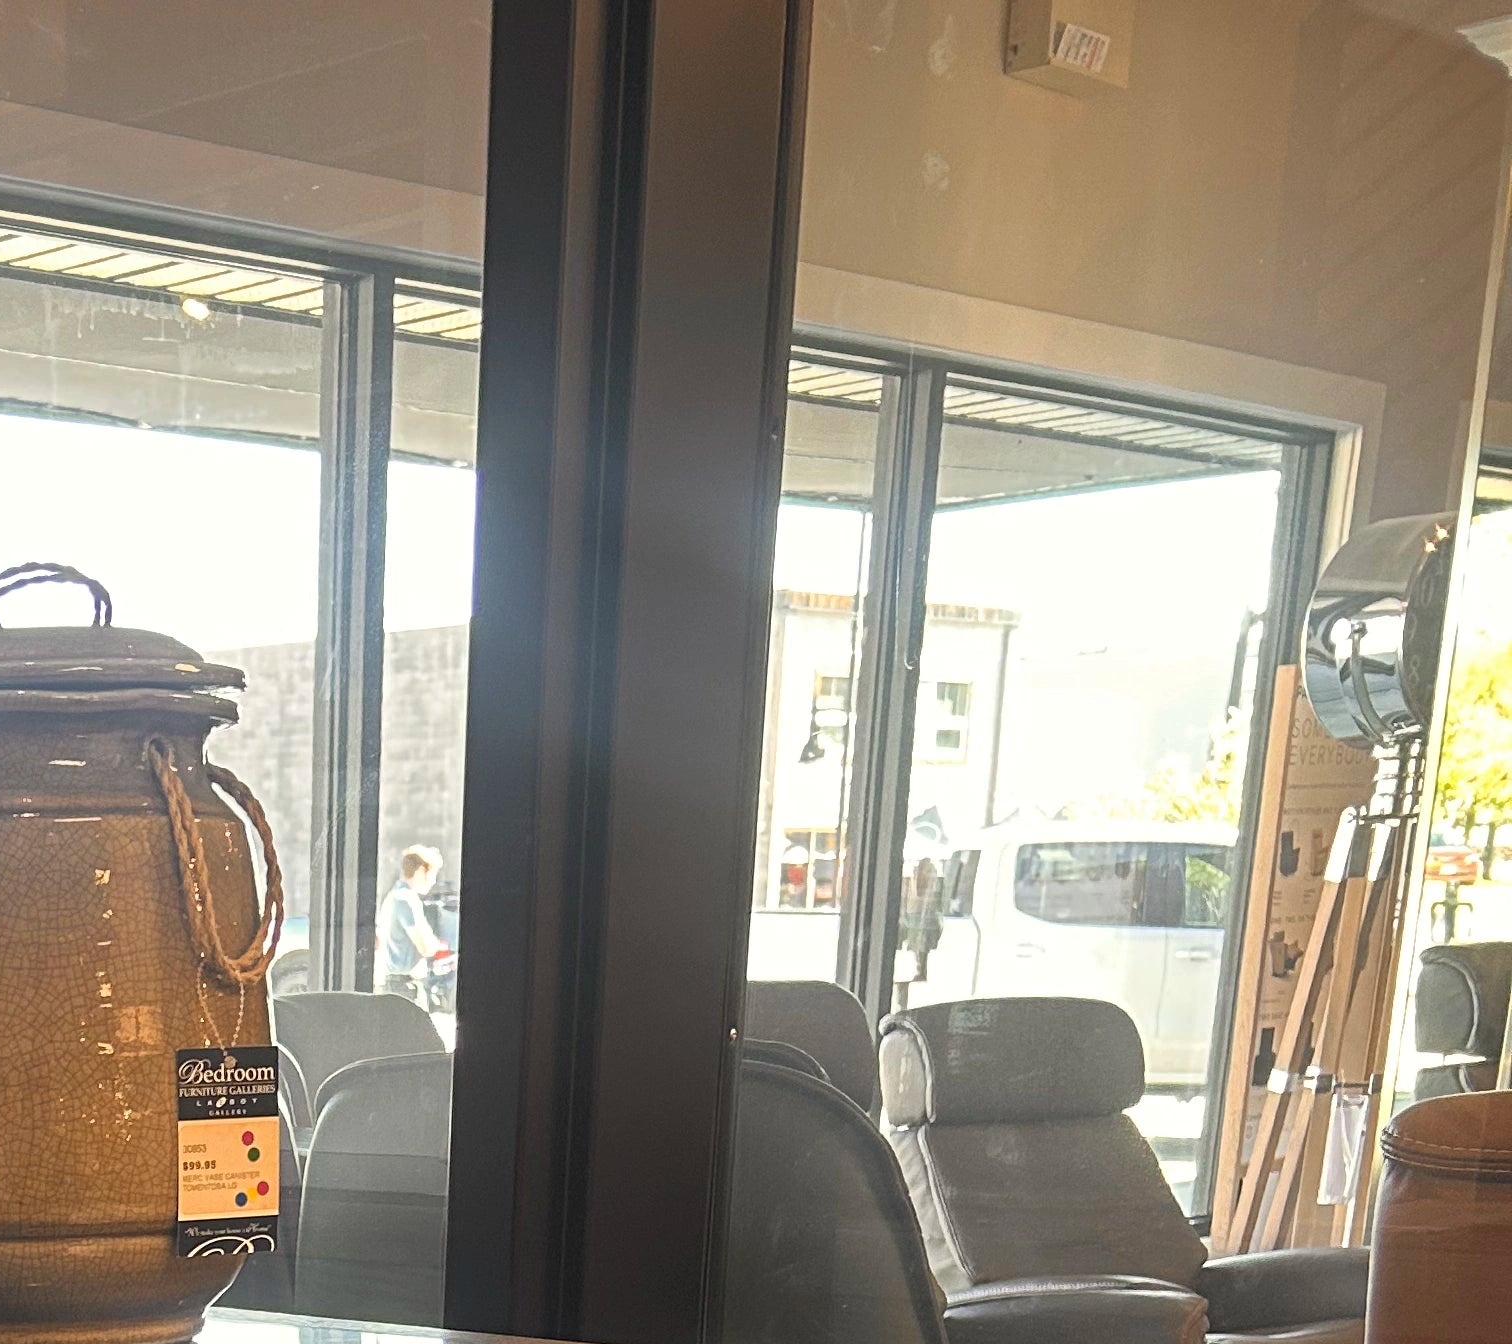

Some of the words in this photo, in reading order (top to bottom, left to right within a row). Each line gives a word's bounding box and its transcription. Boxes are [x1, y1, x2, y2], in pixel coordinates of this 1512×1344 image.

[178, 1058, 276, 1085] Bedroom
[179, 1086, 228, 1097] FURNITURE
[229, 1084, 276, 1095] GALLERIES
[182, 1159, 217, 1171] $99.95
